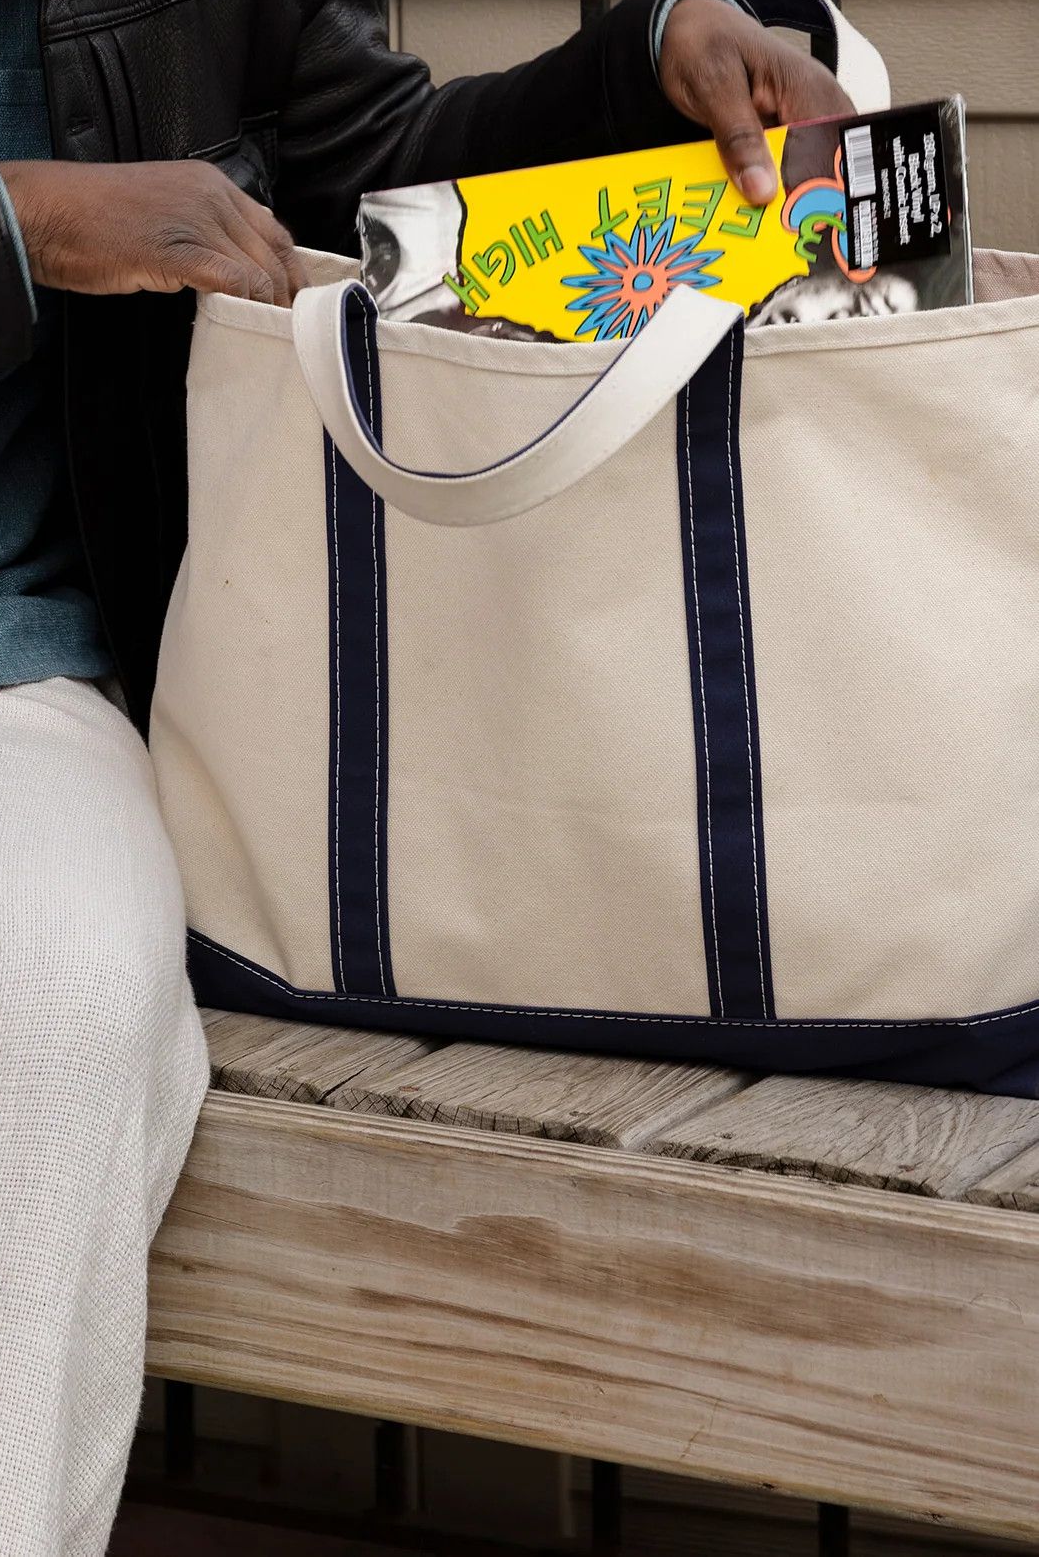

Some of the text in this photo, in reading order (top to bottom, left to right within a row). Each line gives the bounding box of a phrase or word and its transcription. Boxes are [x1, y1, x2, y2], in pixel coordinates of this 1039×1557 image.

[590, 177, 767, 240] FEET
[794, 211, 847, 263] 3
[442, 209, 563, 316] HIGH
